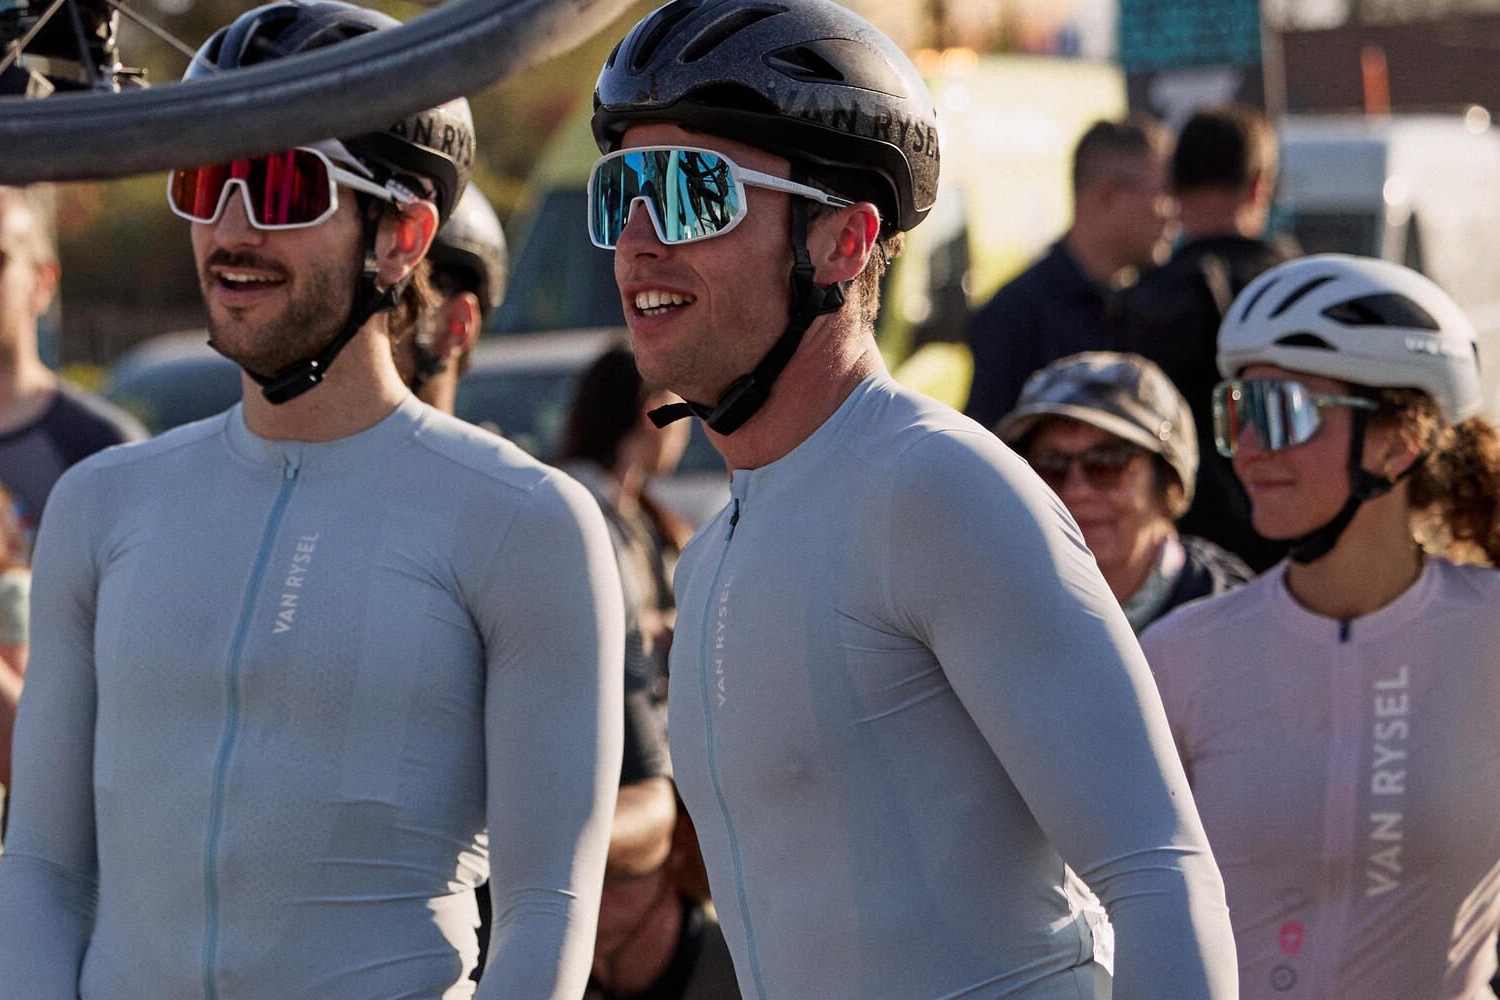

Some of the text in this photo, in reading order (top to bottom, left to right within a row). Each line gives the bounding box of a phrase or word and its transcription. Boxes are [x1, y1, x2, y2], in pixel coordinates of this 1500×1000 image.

[766, 84, 862, 134] VAN
[272, 532, 320, 635] VAN RYSEL
[715, 575, 733, 708] VAN RYSEL
[1365, 666, 1410, 898] VAN RYSEL
